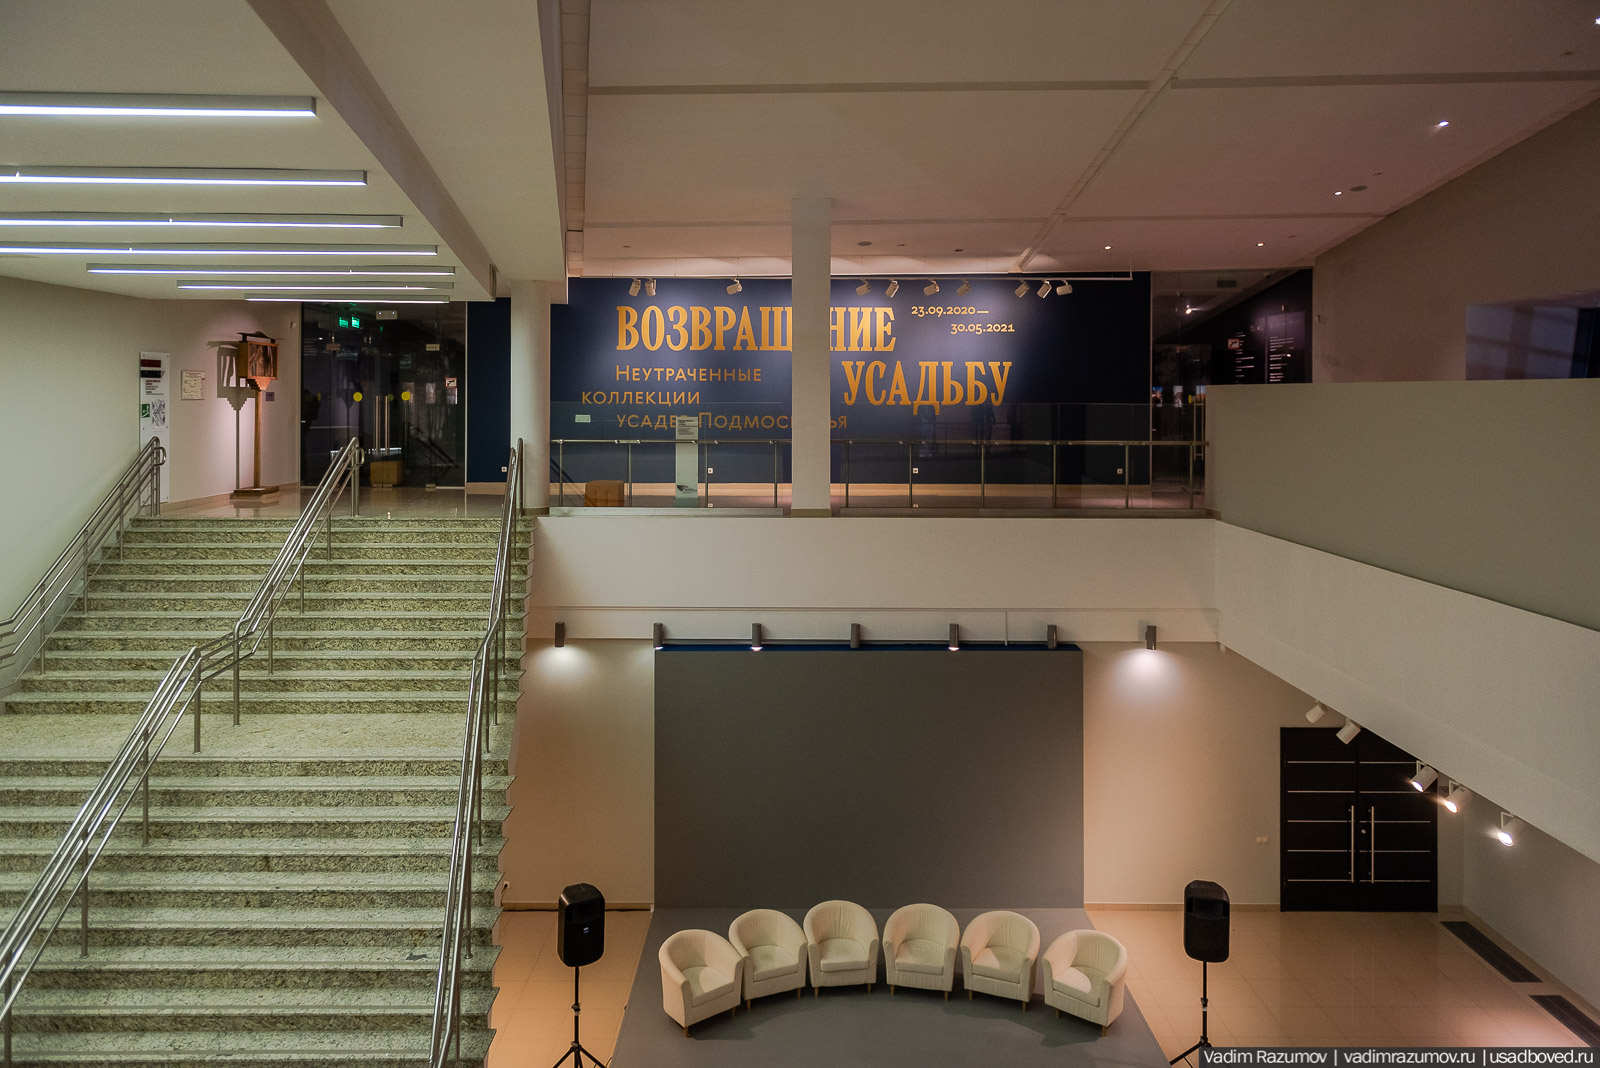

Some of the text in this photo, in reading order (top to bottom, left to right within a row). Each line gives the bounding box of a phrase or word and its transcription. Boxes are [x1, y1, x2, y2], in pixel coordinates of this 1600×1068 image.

[616, 305, 896, 352] ВОЗВРАЩНИЕ
[951, 323, 1016, 335] 30.05.2021
[841, 360, 1012, 416] УСАДЬБУ
[617, 414, 688, 430] УСАДЕ
